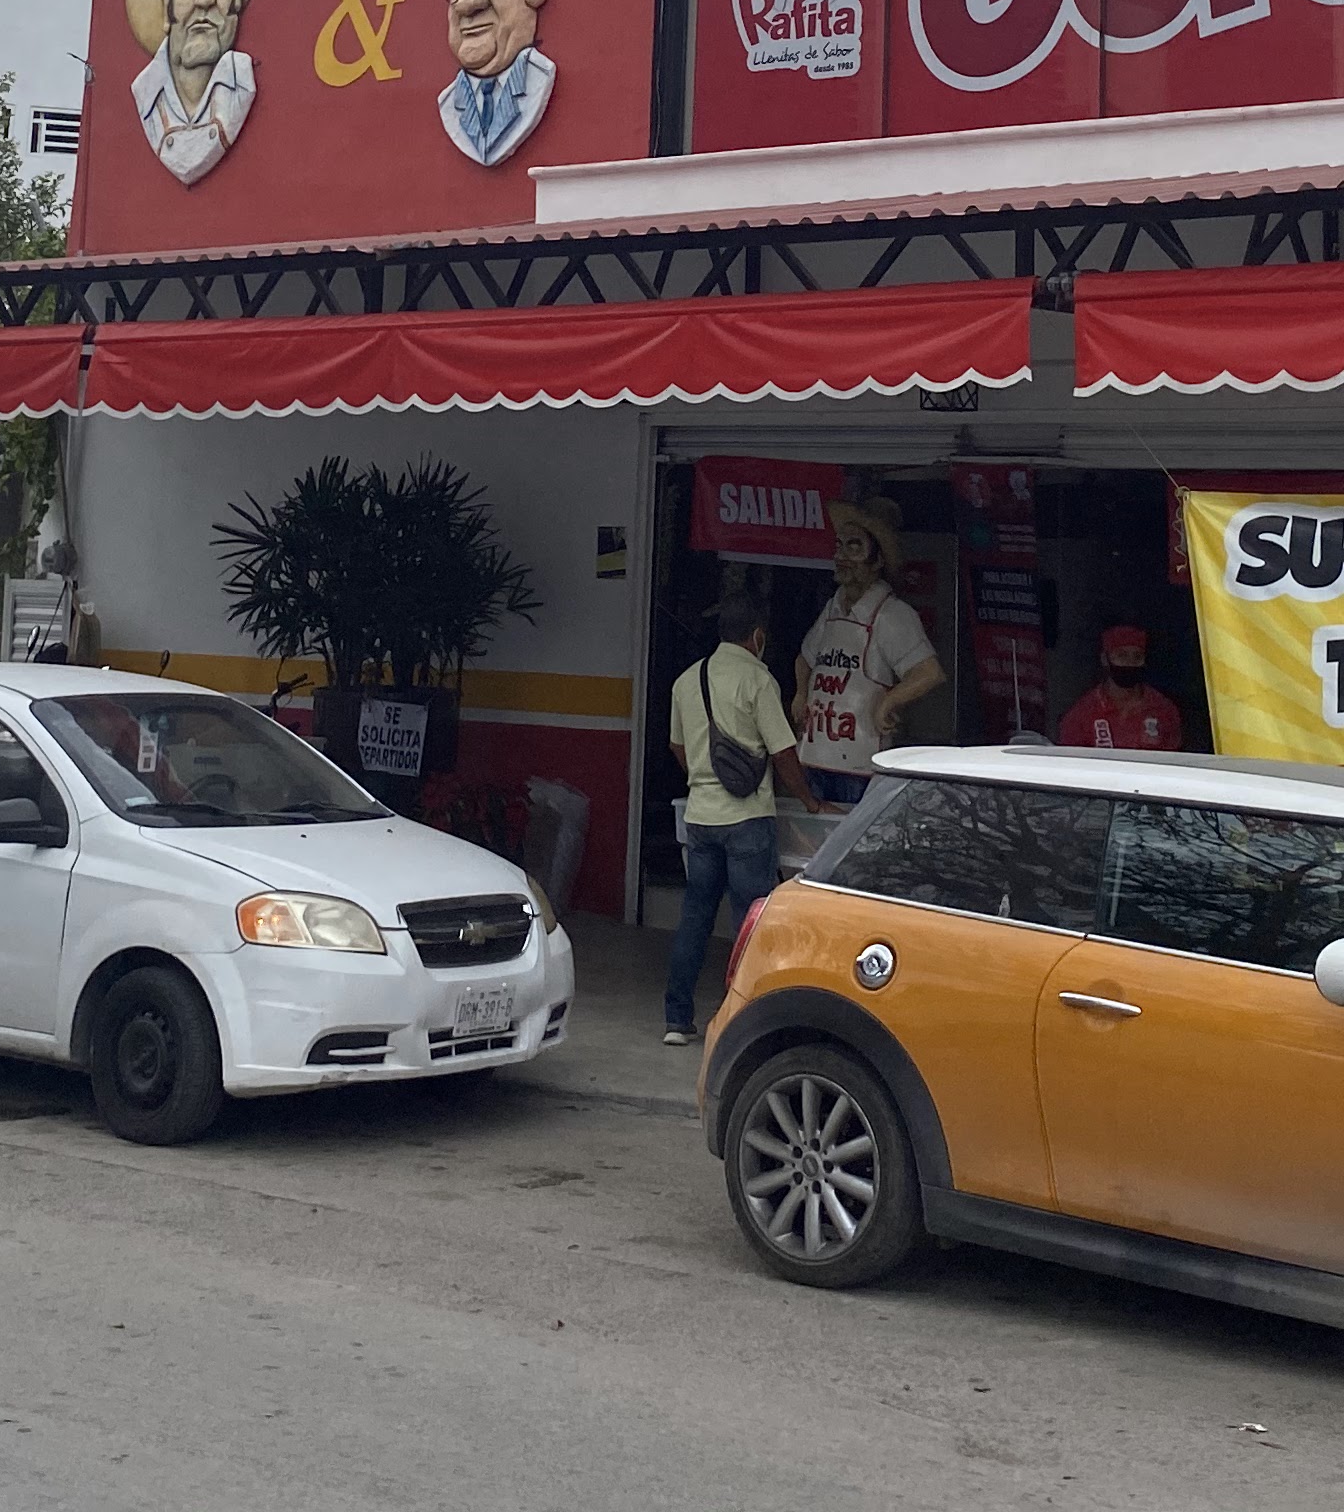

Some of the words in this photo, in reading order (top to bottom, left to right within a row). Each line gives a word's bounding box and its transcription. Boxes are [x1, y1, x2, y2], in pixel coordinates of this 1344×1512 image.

[804, 44, 819, 60] de
[719, 482, 826, 530] SALIDA
[384, 706, 402, 725] SE
[360, 724, 421, 749] SOLICITA
